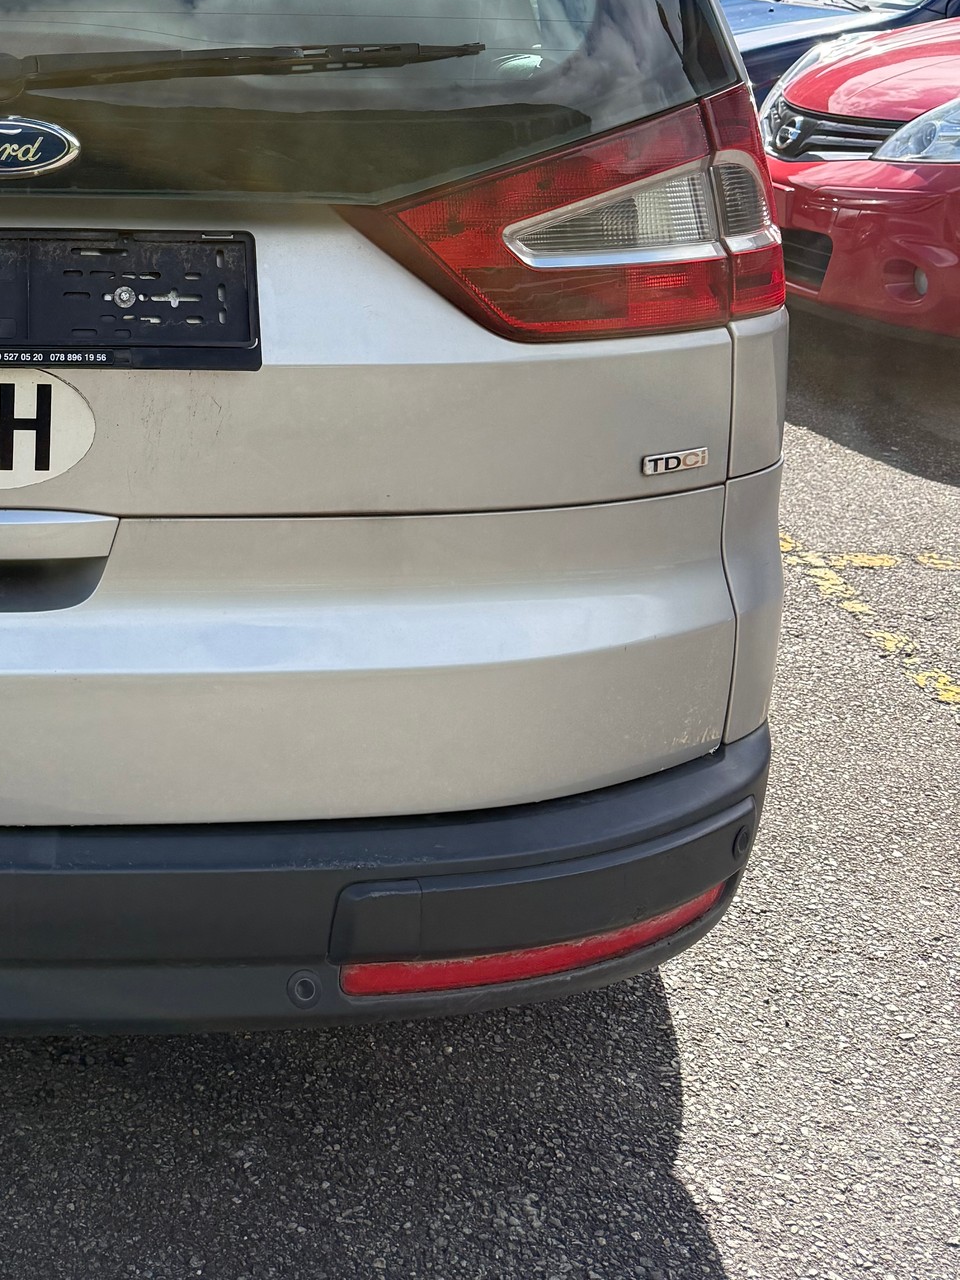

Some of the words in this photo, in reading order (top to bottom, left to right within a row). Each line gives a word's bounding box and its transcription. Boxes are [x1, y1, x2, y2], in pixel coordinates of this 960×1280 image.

[3, 353, 19, 361] 527
[20, 353, 31, 361] 05
[33, 353, 44, 361] 20
[50, 353, 65, 362] 078
[67, 353, 83, 362] 896
[84, 353, 94, 362] 19
[96, 353, 107, 362] 56
[648, 450, 707, 473] TDCi
